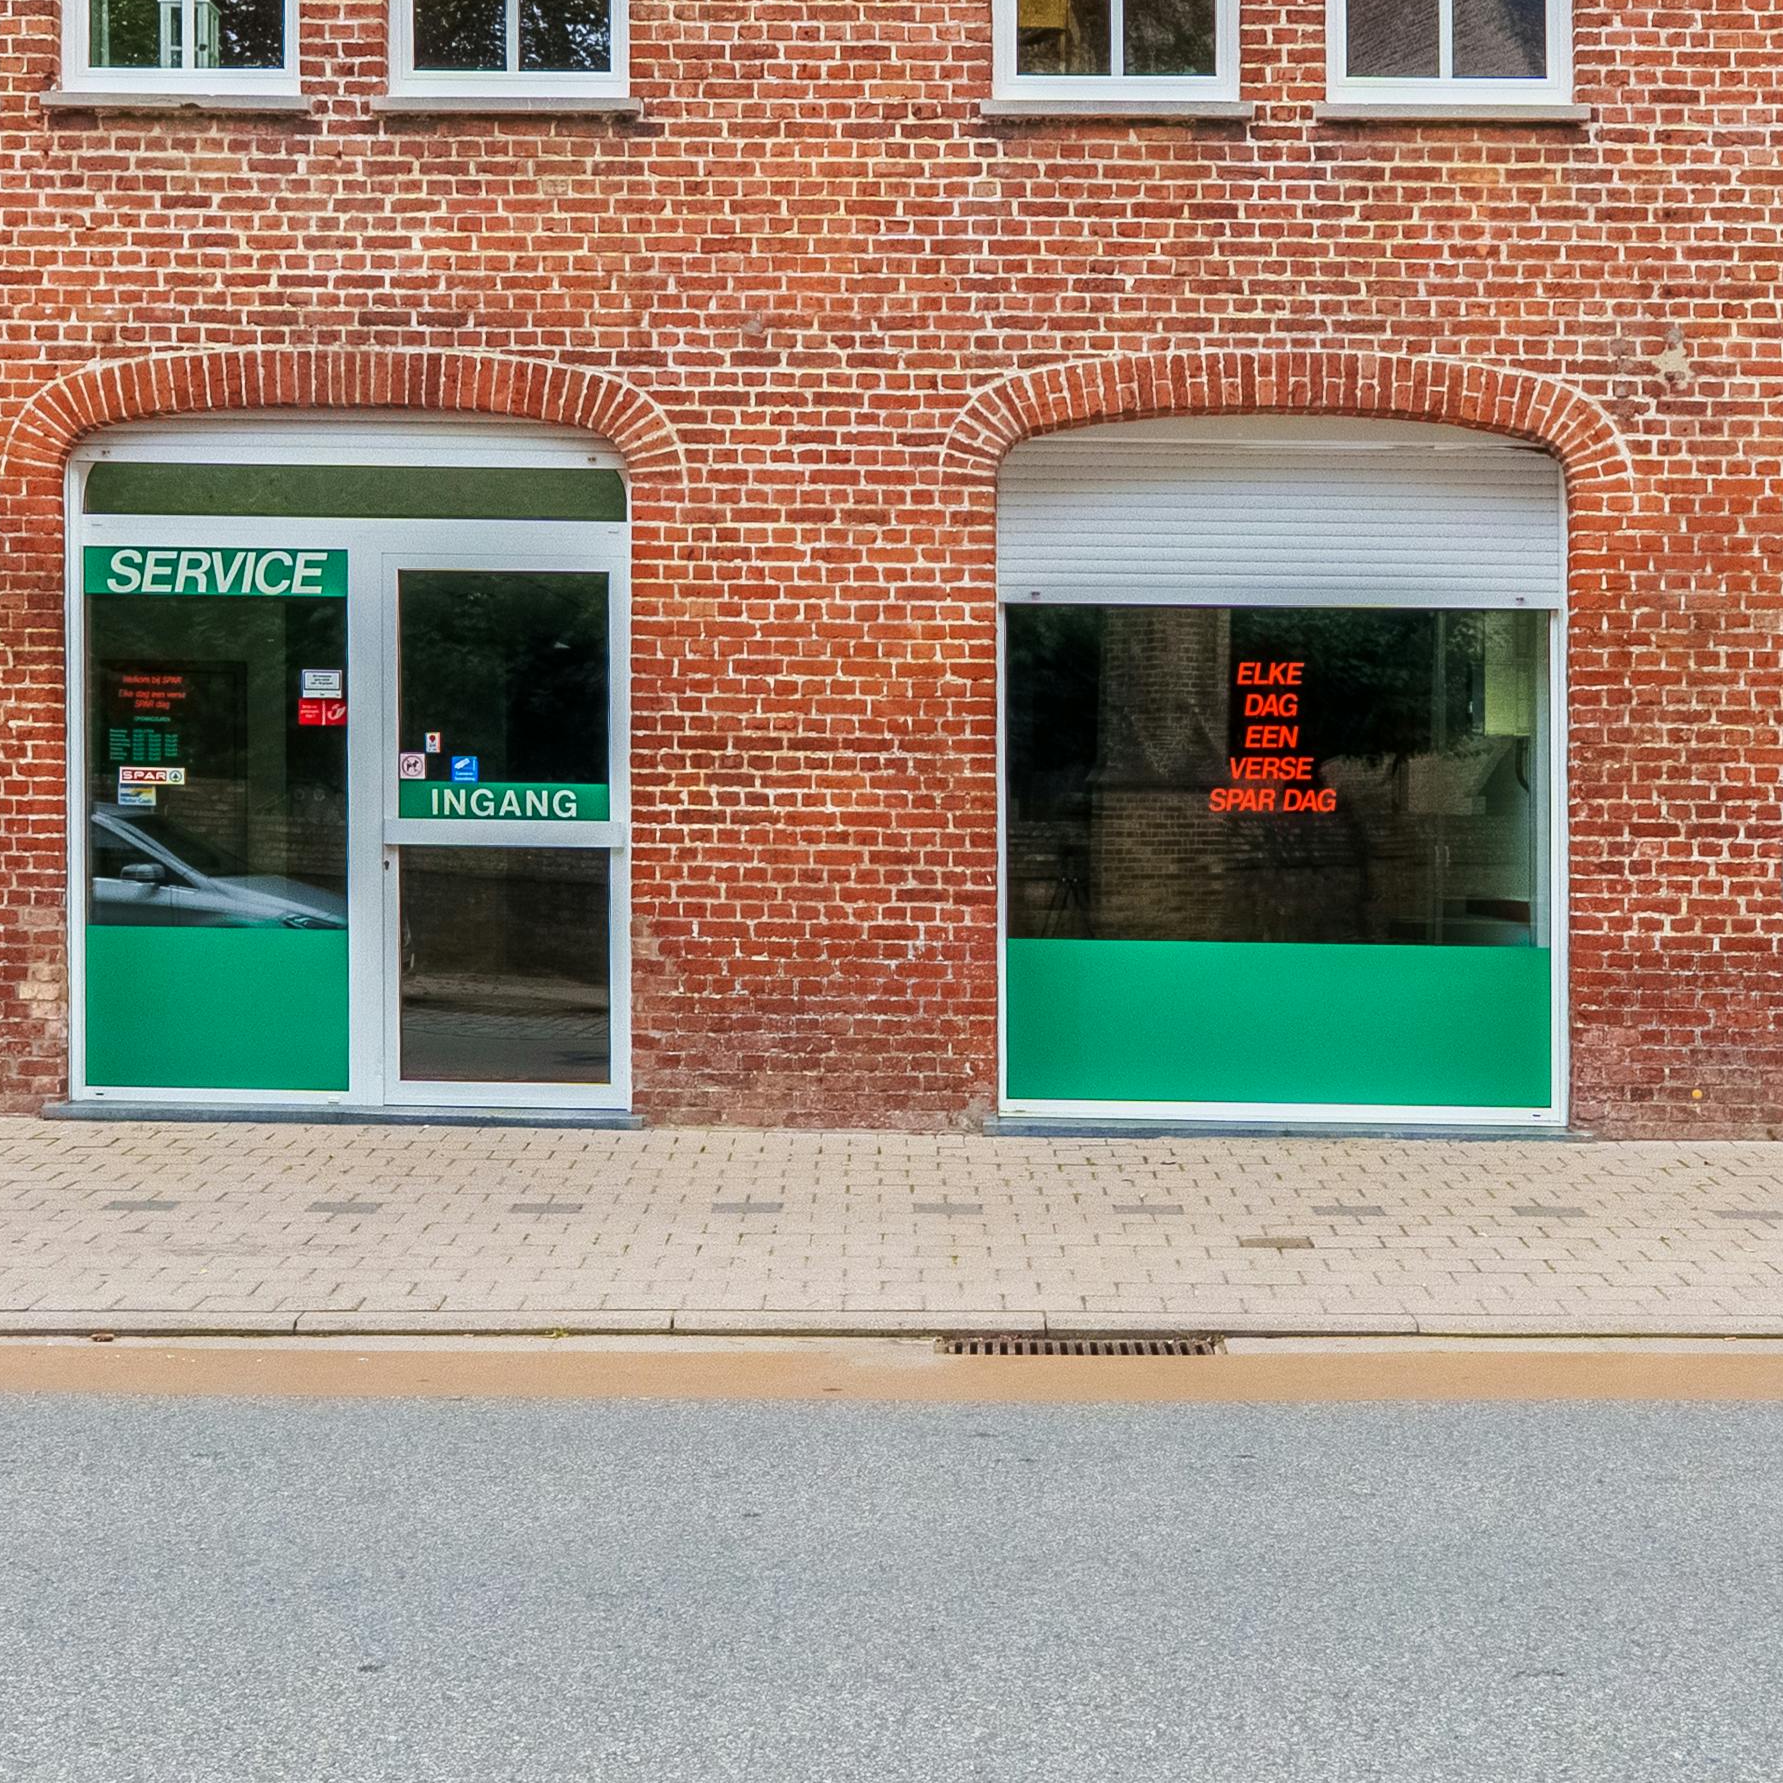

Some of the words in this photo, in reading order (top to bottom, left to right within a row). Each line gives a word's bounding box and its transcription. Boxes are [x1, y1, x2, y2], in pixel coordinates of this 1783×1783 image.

[106, 548, 328, 595] SERVICE
[1236, 662, 1305, 686] ELKE
[1244, 693, 1298, 718] DAG
[1245, 725, 1299, 749] EEN
[122, 770, 166, 780] SPAR
[1229, 757, 1314, 780] VERSE
[431, 789, 578, 818] INGANG
[1209, 788, 1275, 812] SPAR
[1282, 788, 1337, 813] DAG
